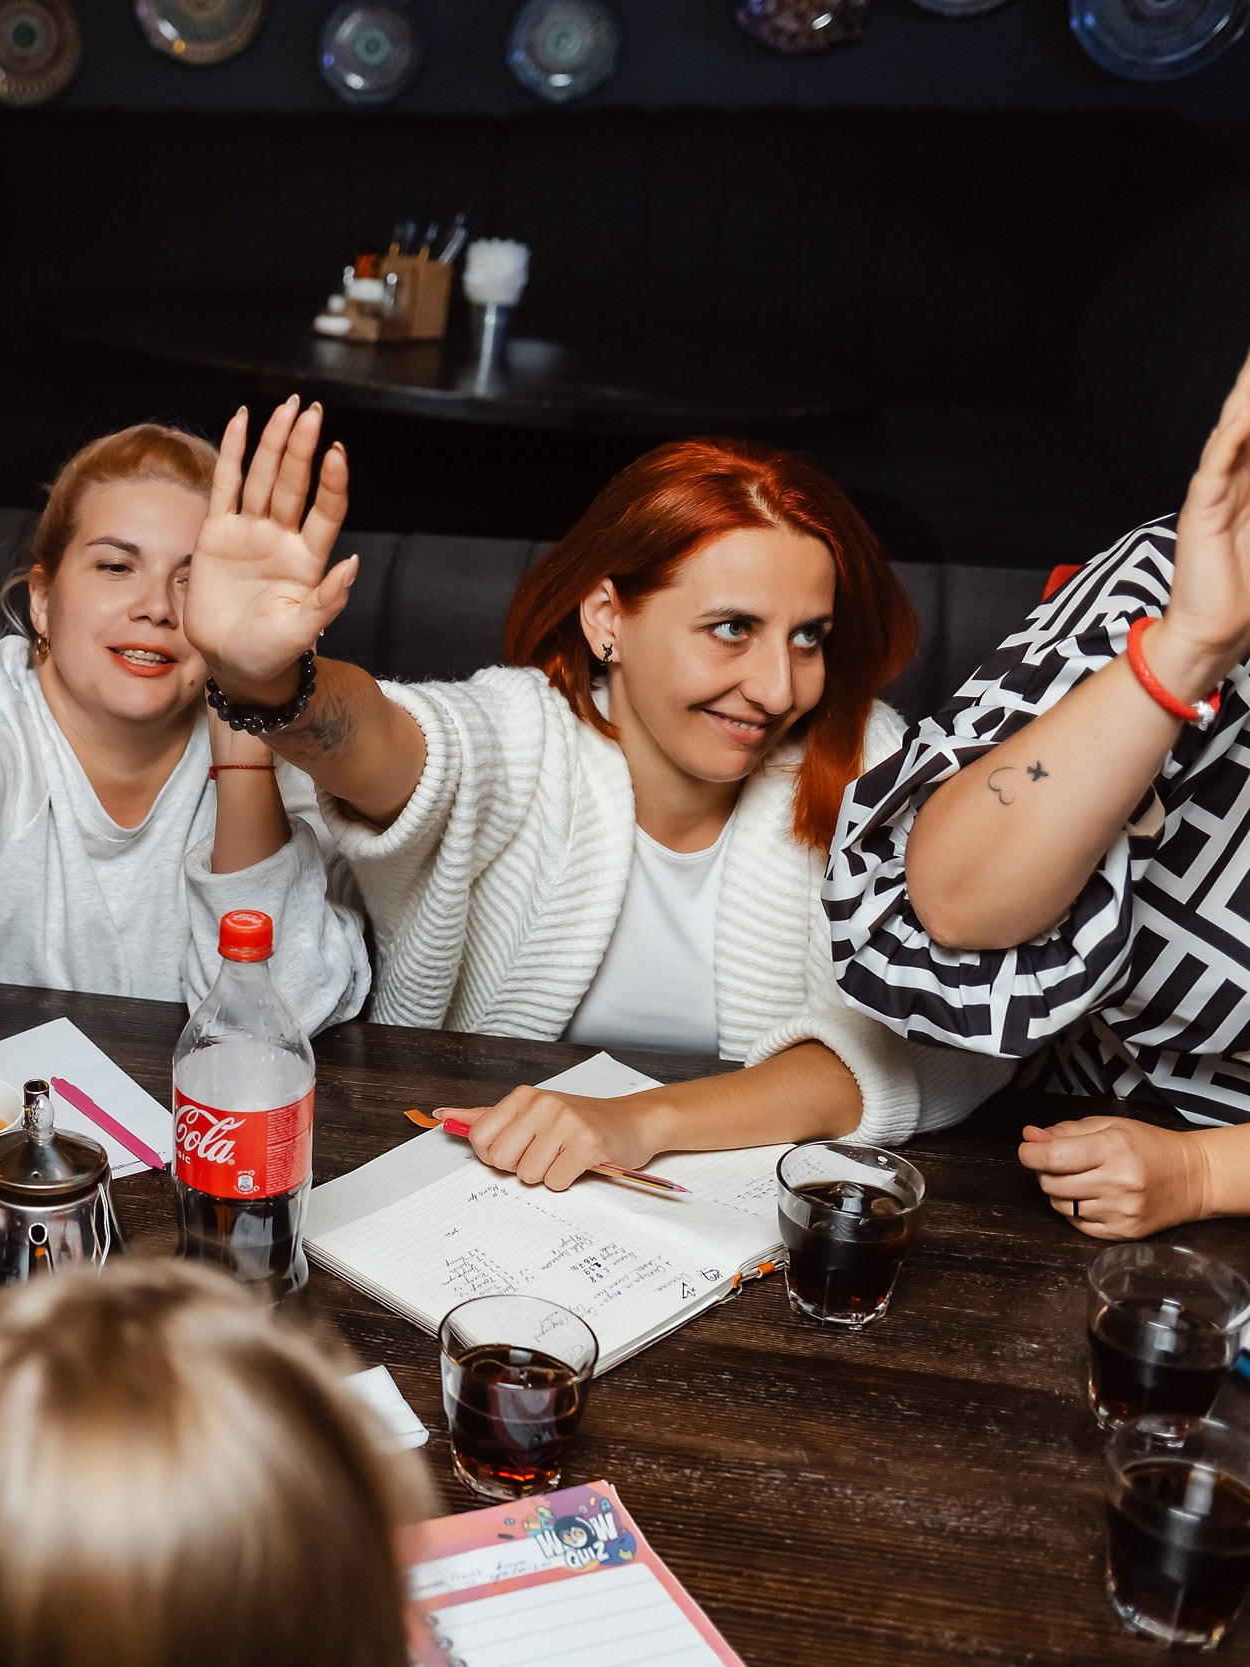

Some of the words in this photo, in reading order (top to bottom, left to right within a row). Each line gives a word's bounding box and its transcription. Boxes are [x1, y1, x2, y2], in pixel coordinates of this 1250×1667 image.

[175, 1105, 247, 1164] Cola
[534, 1511, 619, 1559] WOW
[565, 1540, 610, 1570] QUIZ
